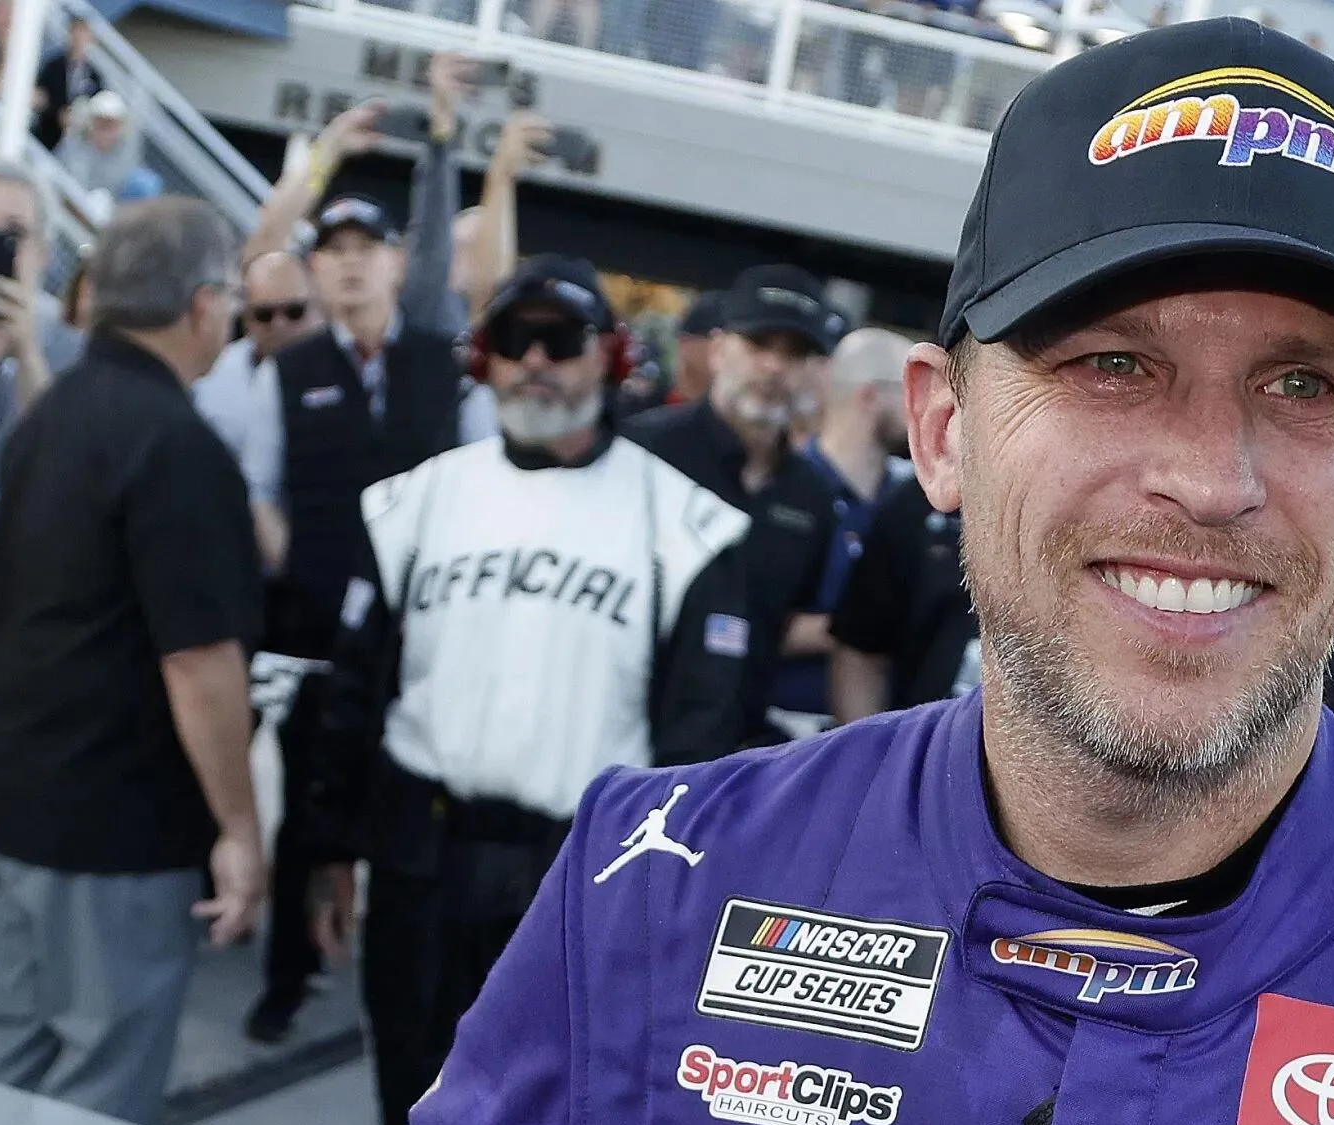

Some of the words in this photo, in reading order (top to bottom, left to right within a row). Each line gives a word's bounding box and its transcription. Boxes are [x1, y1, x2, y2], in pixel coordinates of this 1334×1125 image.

[410, 547, 637, 626] OFFICIAL
[786, 922, 917, 970] NASCAR
[991, 937, 1199, 1004] ampm
[734, 963, 798, 997] CUP
[793, 972, 903, 1015] SERIES
[680, 1048, 897, 1122] SportClips
